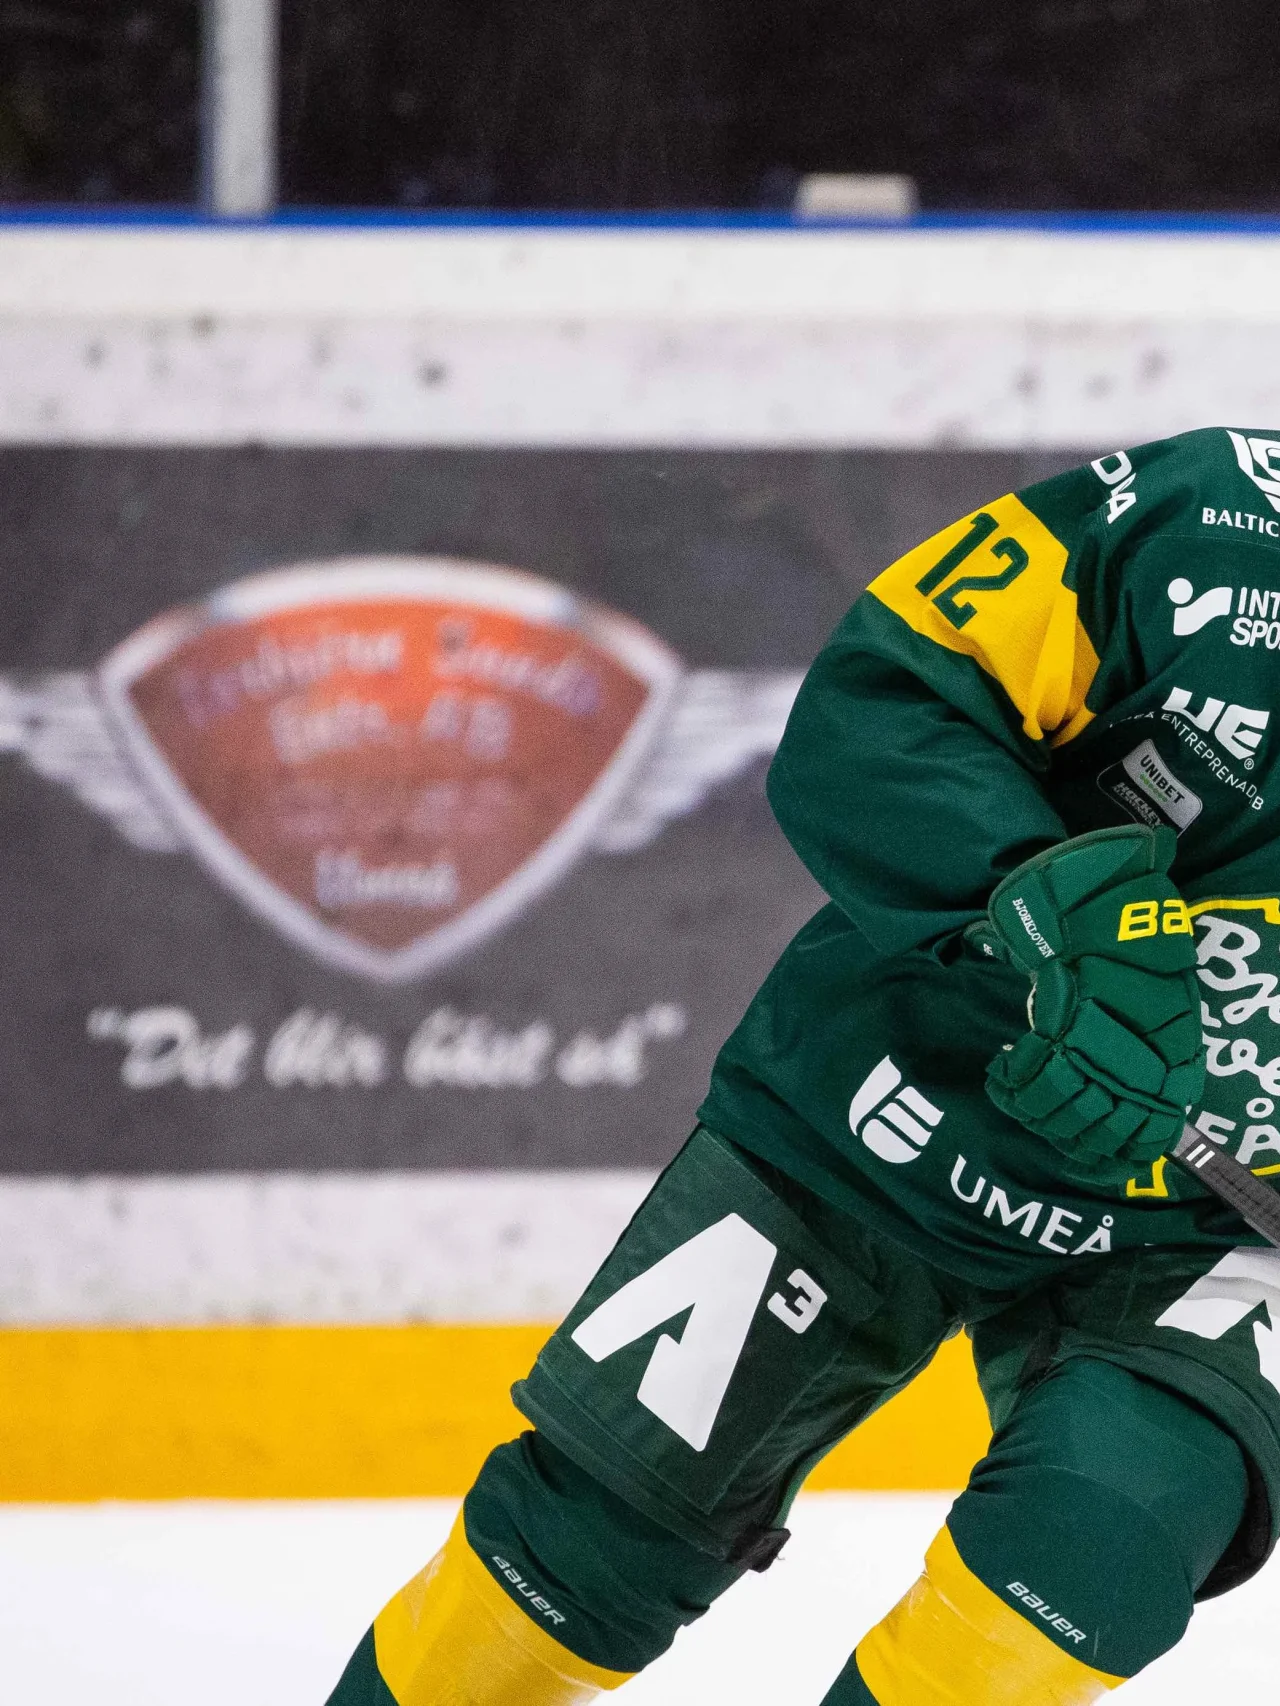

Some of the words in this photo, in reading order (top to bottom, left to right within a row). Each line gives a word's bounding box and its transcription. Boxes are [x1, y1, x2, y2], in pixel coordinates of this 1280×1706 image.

[915, 512, 1029, 630] 12
[1140, 754, 1186, 804] UNIBET
[950, 1153, 1114, 1256] UMEÅ
[491, 1555, 567, 1625] BAUER
[1005, 1581, 1088, 1644] BAUER
